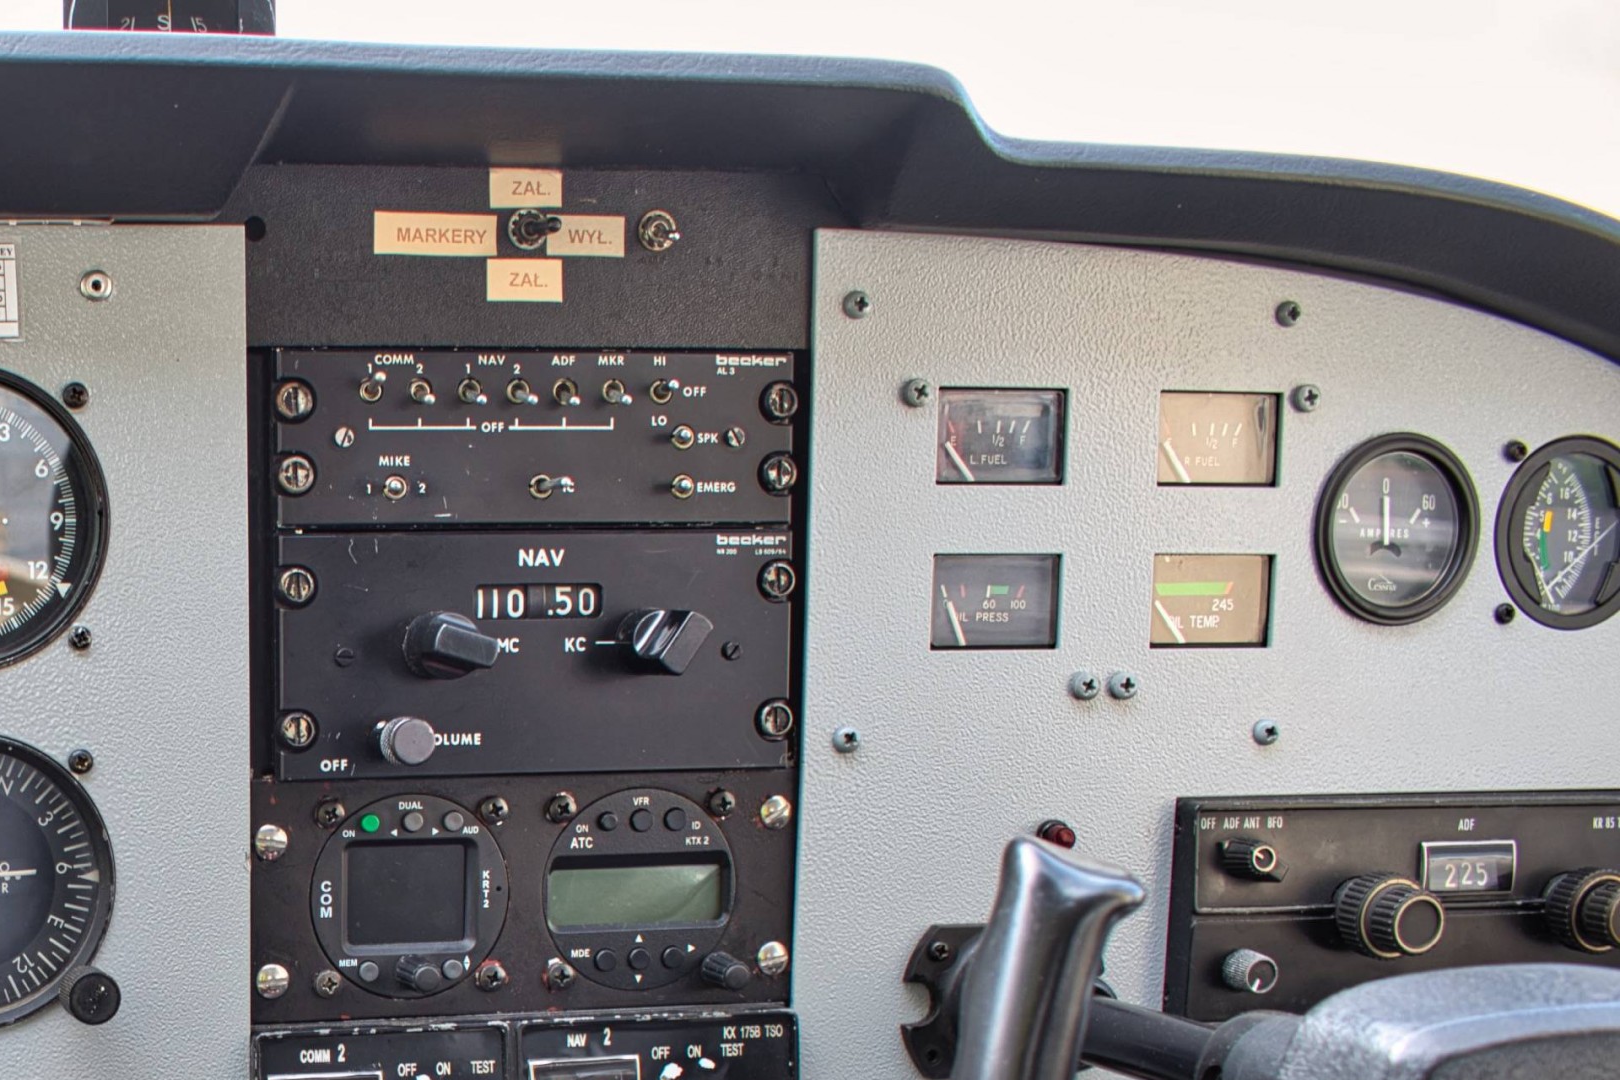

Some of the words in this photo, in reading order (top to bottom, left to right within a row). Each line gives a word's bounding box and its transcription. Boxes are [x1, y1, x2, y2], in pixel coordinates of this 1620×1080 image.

[512, 181, 551, 196] ZAŁ.
[396, 227, 487, 244] MARKERY
[569, 230, 612, 245] WYŁ.
[509, 272, 548, 288] ZAŁ.
[375, 355, 414, 365] COMM
[478, 355, 505, 366] NAV
[552, 355, 575, 366] ADF
[598, 356, 624, 366] MKR
[654, 356, 666, 366] HI
[716, 355, 787, 367] becker
[683, 387, 707, 397] OFF
[652, 416, 667, 427] LO
[481, 422, 504, 433] OFF
[697, 434, 719, 444] SPK
[379, 456, 410, 467] MIKE
[982, 455, 1007, 465] FUEL
[1195, 457, 1220, 467] FUEL
[697, 482, 735, 493] EMERG
[716, 534, 786, 546] becker
[518, 548, 565, 567] NAV
[28, 561, 49, 579] 12
[1368, 577, 1396, 591] Cessna
[478, 589, 524, 619] 110
[983, 600, 996, 609] 60
[1010, 600, 1026, 609] 100
[1212, 599, 1234, 611] 245
[976, 612, 1009, 622] PRESS
[497, 638, 519, 653] MC
[565, 637, 586, 652] KC
[433, 732, 482, 746] OLUME
[320, 759, 349, 772] OFF
[398, 802, 423, 810] DUAL
[633, 797, 649, 806] VFR
[576, 825, 588, 833] ON
[692, 821, 701, 830] ID
[1201, 817, 1216, 830] OFF
[1223, 817, 1240, 830] ADF
[1244, 817, 1260, 830] ANT
[1267, 817, 1283, 829] BFO
[1458, 818, 1475, 831] ADF
[342, 830, 355, 838] ON
[462, 826, 479, 834] AUD
[570, 837, 593, 849] ATC
[686, 837, 701, 845] KTX
[1445, 862, 1488, 889] 225
[571, 949, 590, 958] MDE
[339, 959, 357, 967] MEM
[723, 1026, 736, 1039] KX
[765, 1024, 783, 1037] TSO
[567, 1034, 587, 1047] NAV
[604, 1028, 611, 1045] 2
[300, 1049, 330, 1064] COMM
[338, 1044, 345, 1062] 2
[652, 1047, 670, 1059] OFF
[687, 1045, 702, 1058] ON
[721, 1044, 744, 1056] TEST
[397, 1063, 417, 1077] OFF
[436, 1062, 451, 1075] ON
[471, 1060, 495, 1074] TEST
